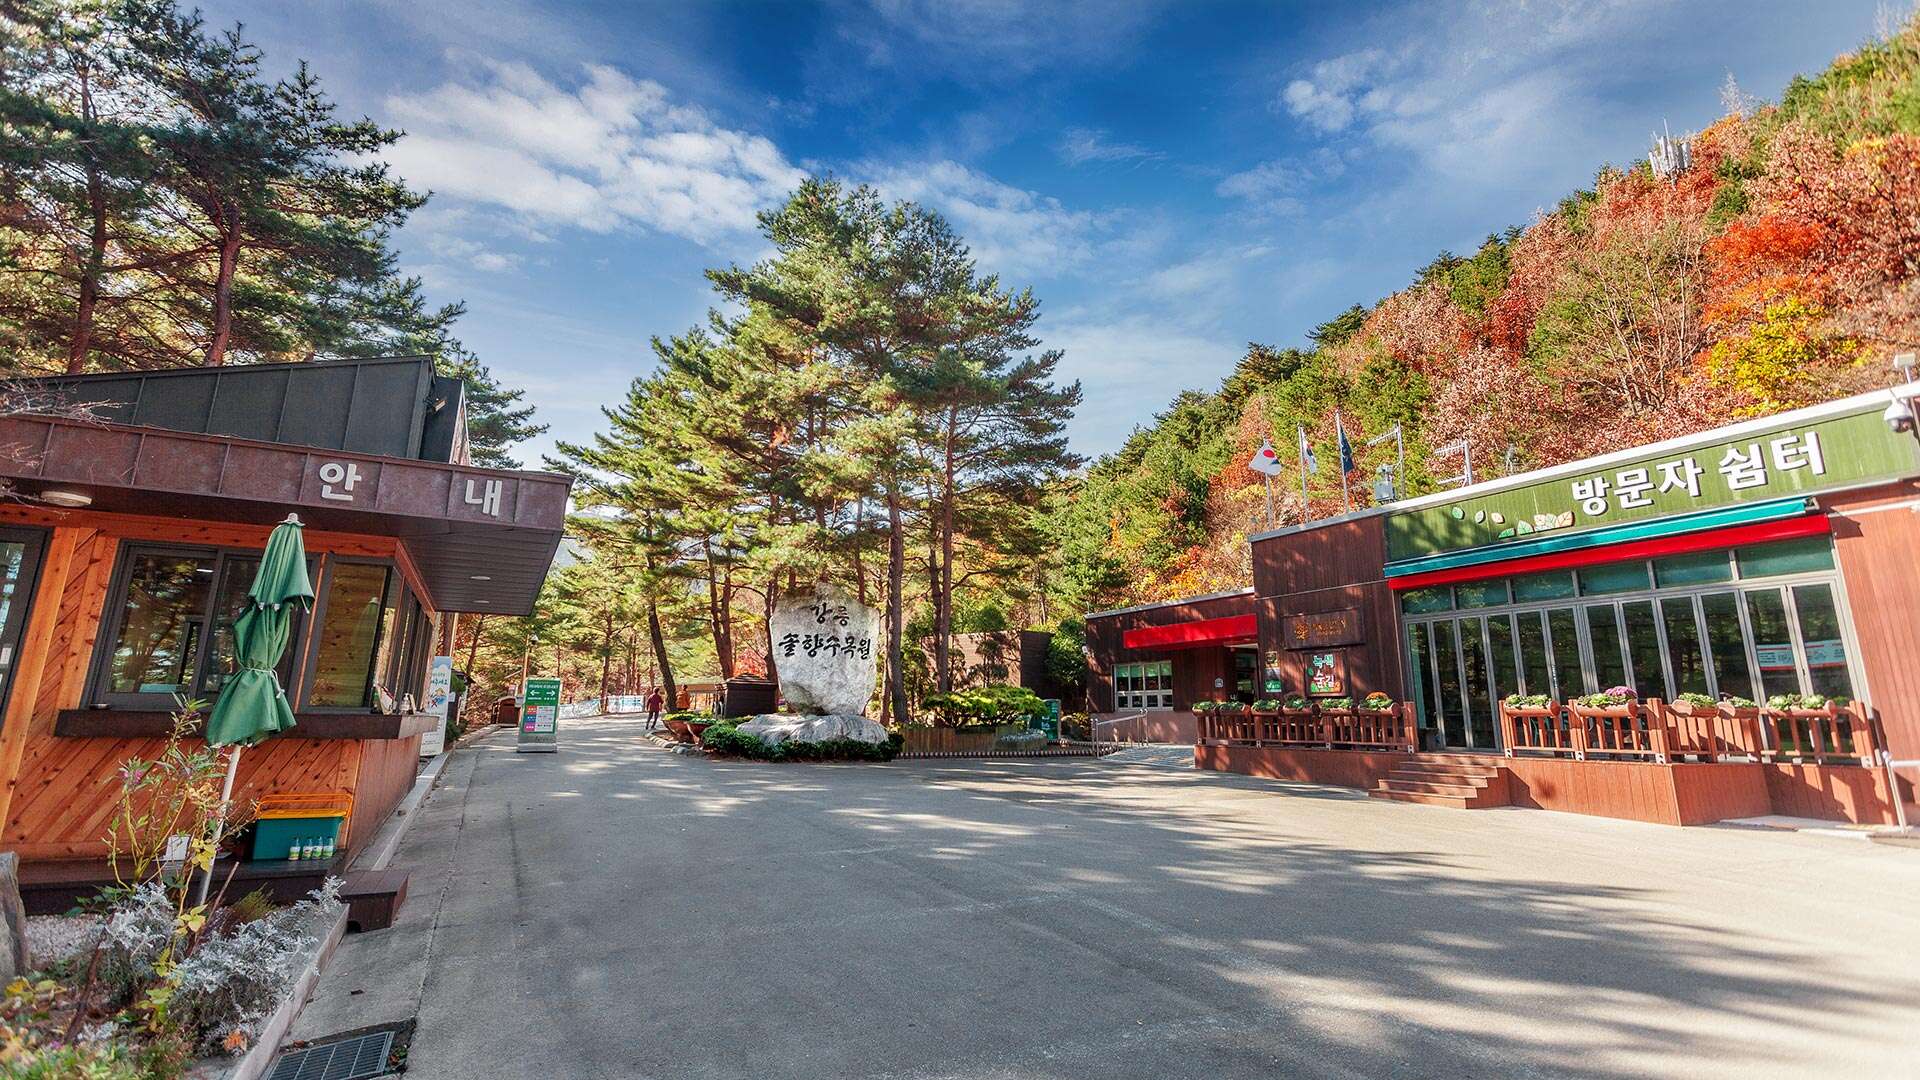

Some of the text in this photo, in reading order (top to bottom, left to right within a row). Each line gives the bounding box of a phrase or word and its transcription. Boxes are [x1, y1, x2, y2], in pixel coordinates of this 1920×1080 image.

[1571, 431, 1826, 516] 방문자 쉼터
[810, 602, 850, 626] 강릉
[778, 632, 871, 660] 솔향수목원
